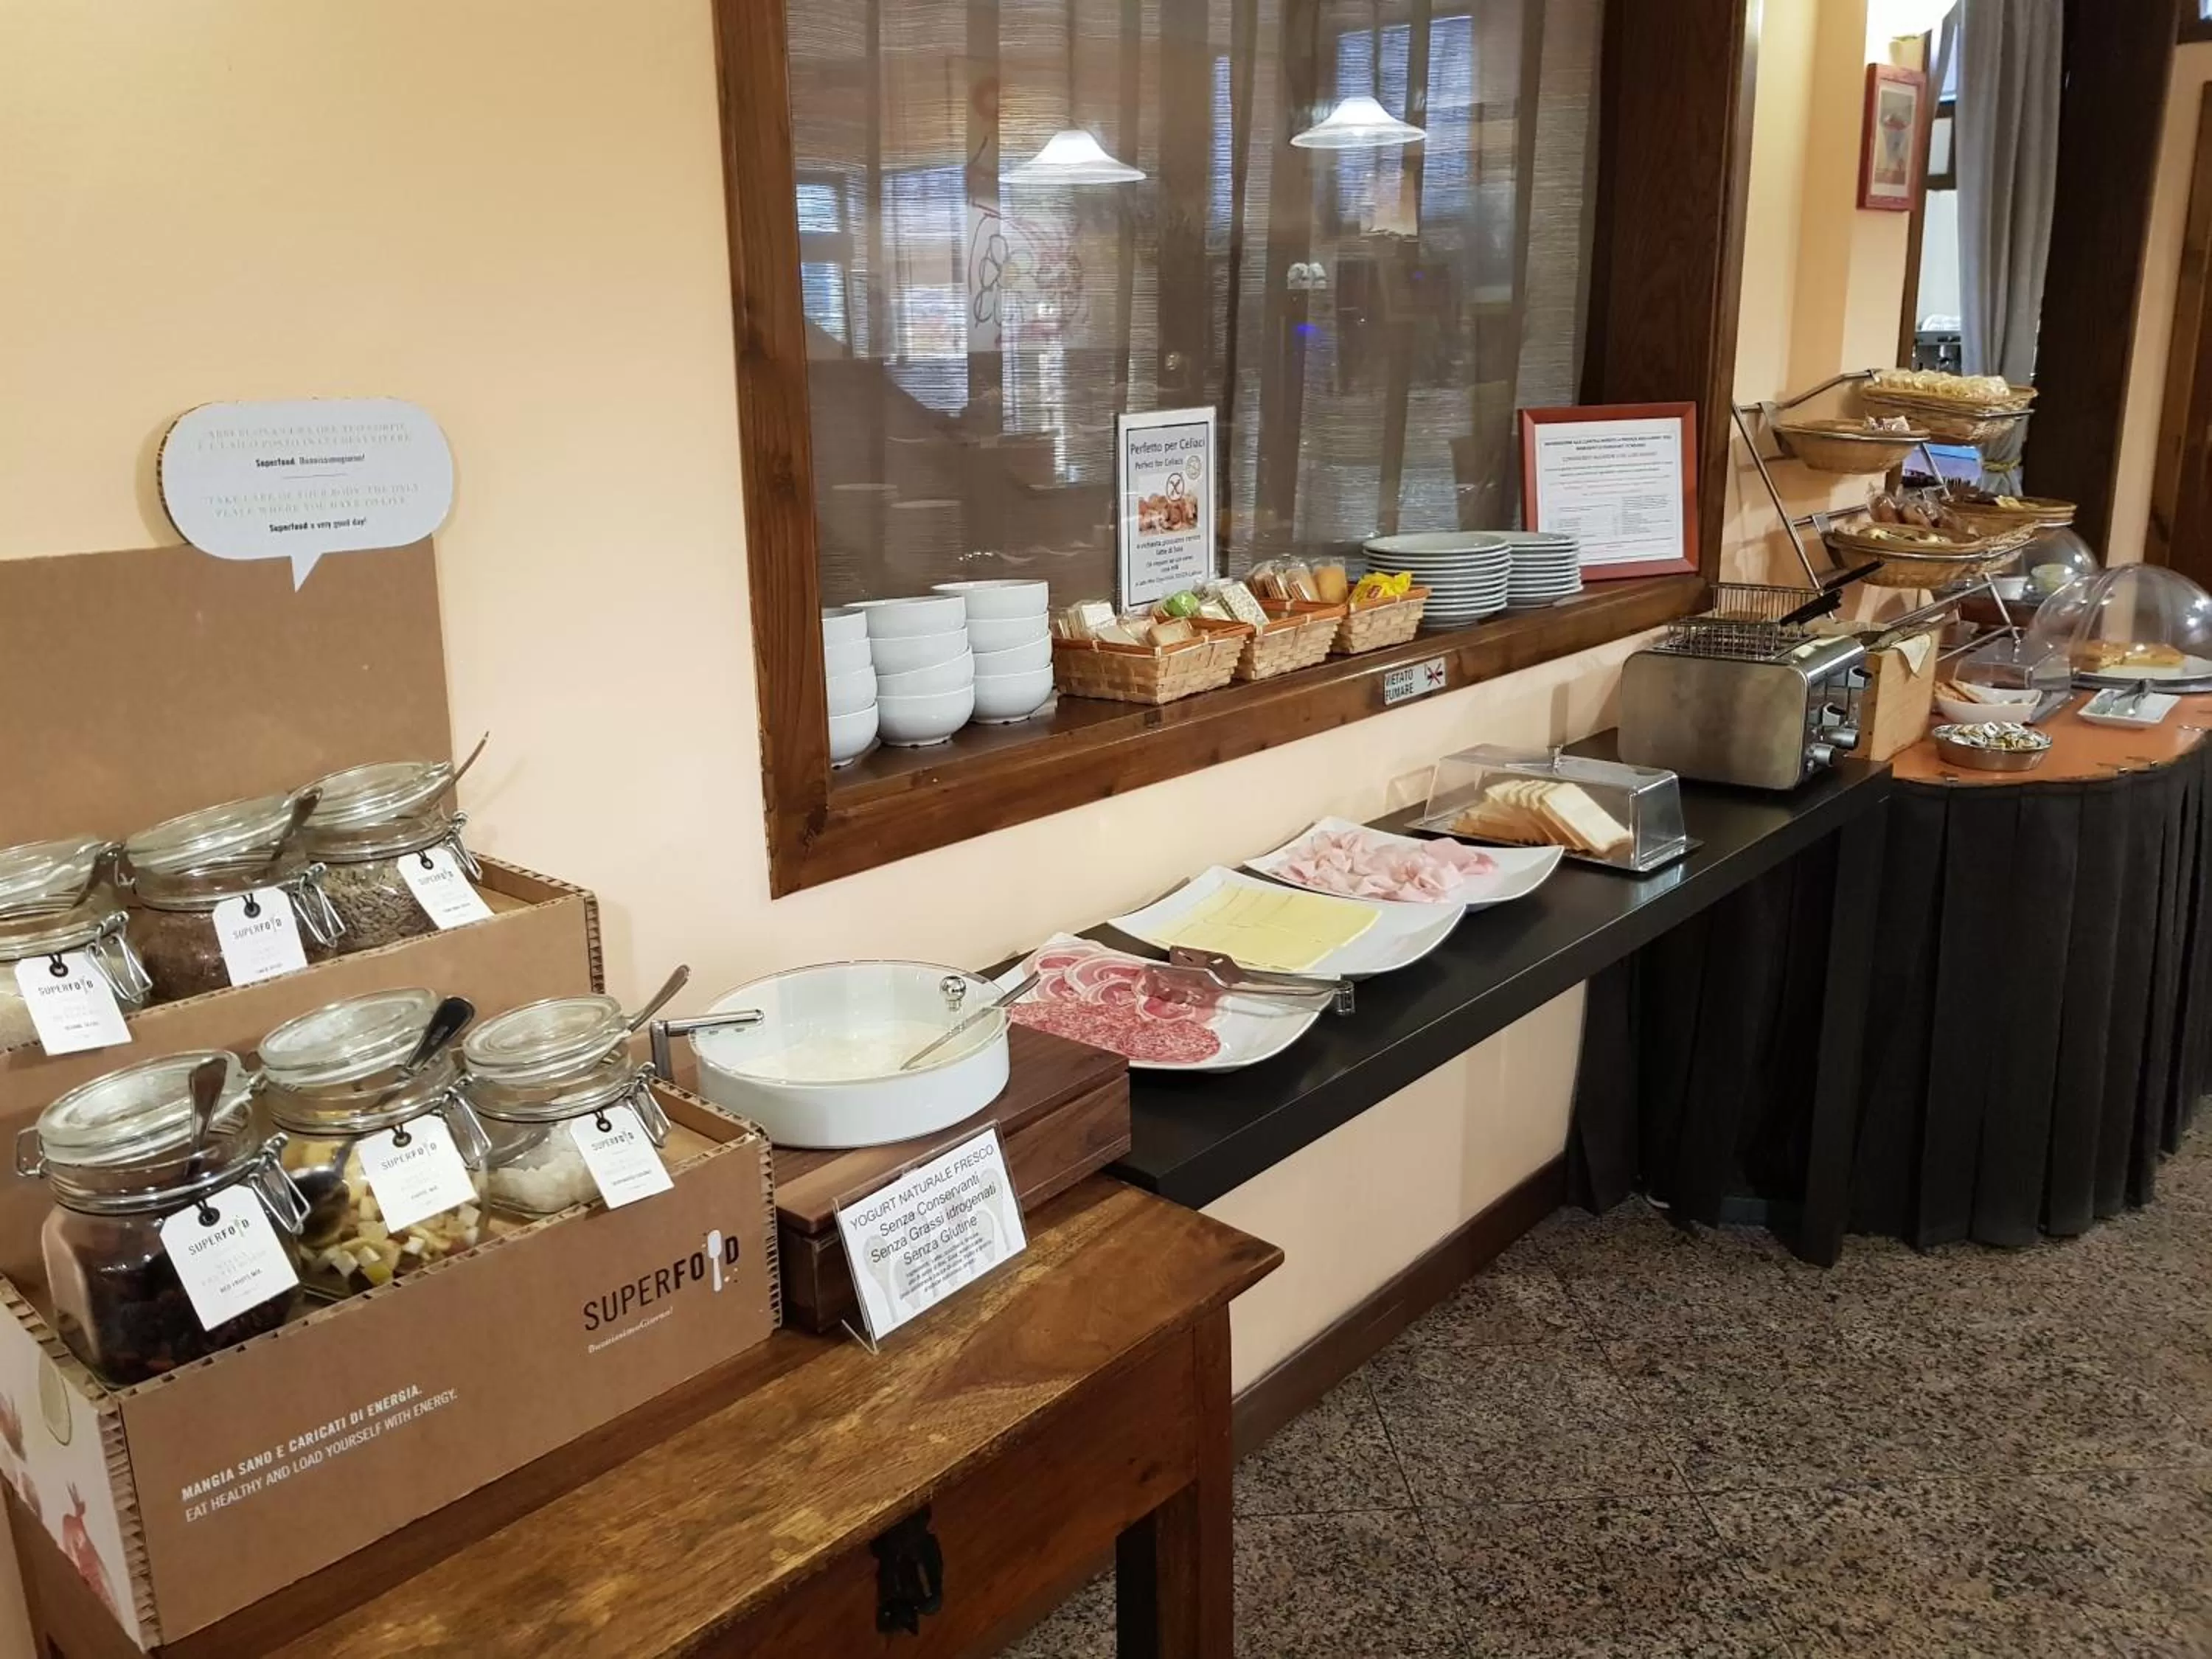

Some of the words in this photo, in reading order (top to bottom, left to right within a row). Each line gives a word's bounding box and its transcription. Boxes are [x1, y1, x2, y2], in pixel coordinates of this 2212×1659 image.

[1130, 442, 1163, 455] Perfetto
[1165, 442, 1178, 453] per
[1385, 683, 1413, 701] FUMARE
[849, 1197, 897, 1231] YOGURT
[899, 1166, 953, 1206] NATURALE
[953, 1144, 995, 1175] FRESCO
[880, 1211, 915, 1237] Senza
[917, 1171, 980, 1216] Conservanti
[871, 1237, 908, 1263] Senza
[909, 1211, 945, 1241] Grassi
[904, 1239, 939, 1265] Senza
[940, 1214, 978, 1243] Glutine
[181, 1467, 234, 1502] MANGIA
[237, 1450, 273, 1475] SANO
[276, 1444, 286, 1458] E
[288, 1416, 347, 1453] CARICATI
[349, 1408, 364, 1425] DI
[366, 1383, 422, 1417] ENERGIA.
[185, 1501, 208, 1523] EAT
[210, 1476, 263, 1511] HEALTHY
[265, 1465, 291, 1486] AND
[292, 1450, 323, 1473] LOAD
[324, 1421, 382, 1458] YOURSELF
[383, 1408, 411, 1430] WITH
[412, 1386, 459, 1417] ENERGY.
